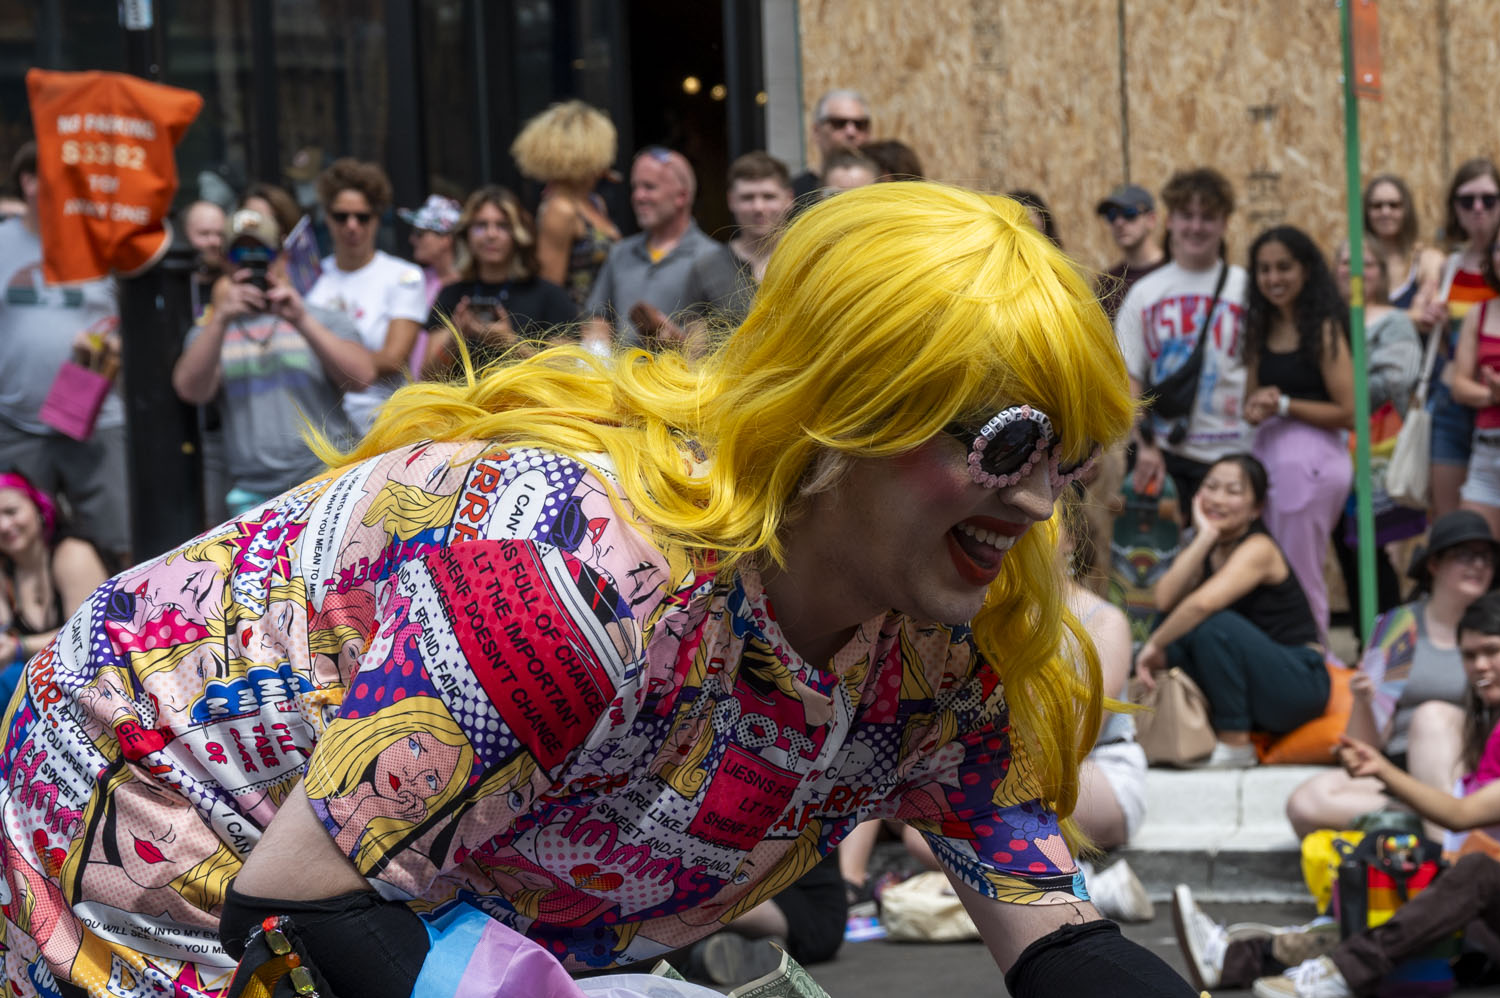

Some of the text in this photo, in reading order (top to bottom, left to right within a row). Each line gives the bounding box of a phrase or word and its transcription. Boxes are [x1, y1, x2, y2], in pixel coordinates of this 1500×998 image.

[323, 492, 338, 516] WHAT
[337, 491, 352, 514] INTO
[318, 517, 330, 537] YOU
[311, 537, 323, 568] MEAN
[310, 567, 320, 581] TO
[510, 563, 541, 612] FULL
[535, 613, 561, 642] OF
[439, 547, 472, 598] SHENF
[464, 600, 519, 686] DOESN'T
[511, 686, 564, 755] CHANGE
[473, 551, 581, 730] LT THE IMPORTANT
[42, 723, 63, 750] YOU
[61, 750, 83, 775] ARE
[70, 724, 98, 755] LOVE
[204, 741, 229, 765] OF
[252, 722, 281, 769] TAKE
[40, 762, 79, 802] SWEET
[722, 759, 777, 796] LIESNS
[596, 802, 646, 840] SWEET
[622, 789, 653, 813] ARE
[649, 807, 684, 832] LIKE
[738, 798, 760, 814] LT
[703, 811, 752, 835] SHENF
[102, 924, 128, 936] WILL
[184, 944, 208, 954] YOU
[154, 926, 181, 936] INTO
[184, 929, 200, 938] MY
